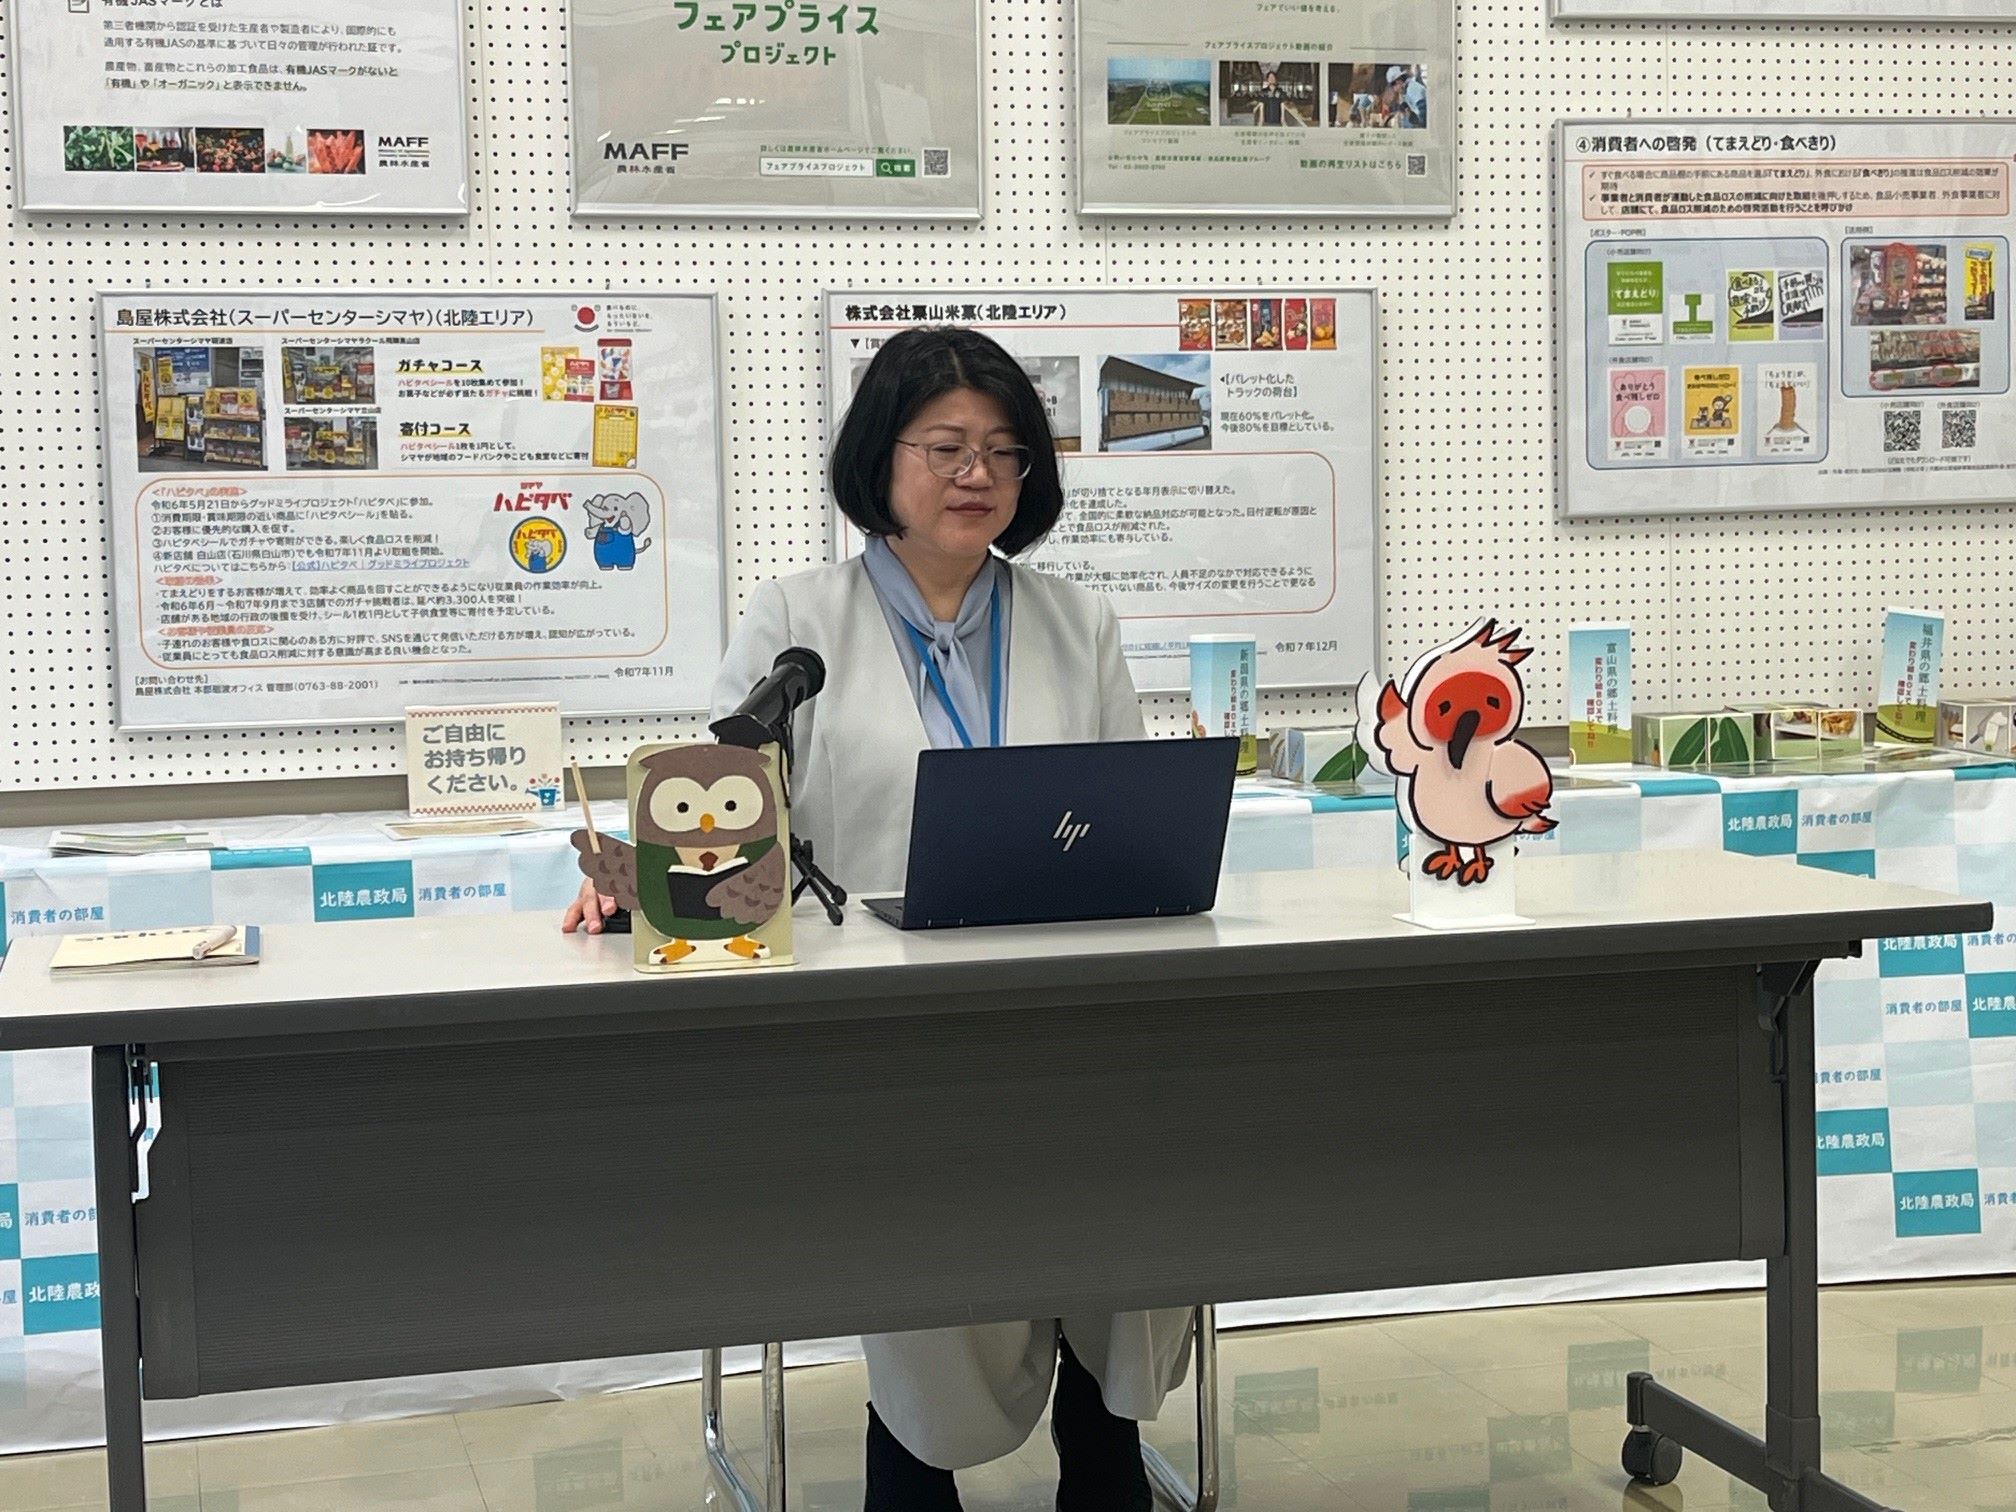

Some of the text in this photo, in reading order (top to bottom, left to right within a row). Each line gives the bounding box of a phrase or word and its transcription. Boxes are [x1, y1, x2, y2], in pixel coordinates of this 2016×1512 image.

[673, 0, 880, 35] フェアプライス
[720, 41, 837, 66] プロジェクト
[378, 136, 429, 147] MAFF
[603, 142, 689, 161] MAFF
[1300, 159, 1402, 171] 動画の再生リストはこちら
[116, 308, 533, 327] 島屋株式会社(スーパーセンターシマヤ)(北陸エリア)
[845, 303, 1067, 321] 株式会社栗山米菓(北陸エリア)
[398, 359, 483, 372] ガチャコース
[1619, 382, 1656, 392] ありがとう
[400, 422, 471, 436] 寄付コース
[493, 493, 572, 511] ハピタベ
[1065, 499, 1128, 509] 化を達成した。
[614, 666, 674, 678] 令和7年11月
[423, 723, 506, 744] ご自由に
[424, 746, 526, 769] お持ち帰り
[427, 773, 518, 795] ください。
[1727, 813, 1793, 832] 北陸農政局
[1801, 811, 1872, 828] 消費者の部屋
[320, 887, 408, 908] 北陸農政局
[418, 883, 507, 902] 消費者の部屋
[10, 905, 104, 926] 消費者の部屋
[1885, 999, 1962, 1016] 消費者の部屋
[1815, 1068, 1881, 1083] 費者の部屋
[1899, 1192, 1975, 1211] 北陸農政局
